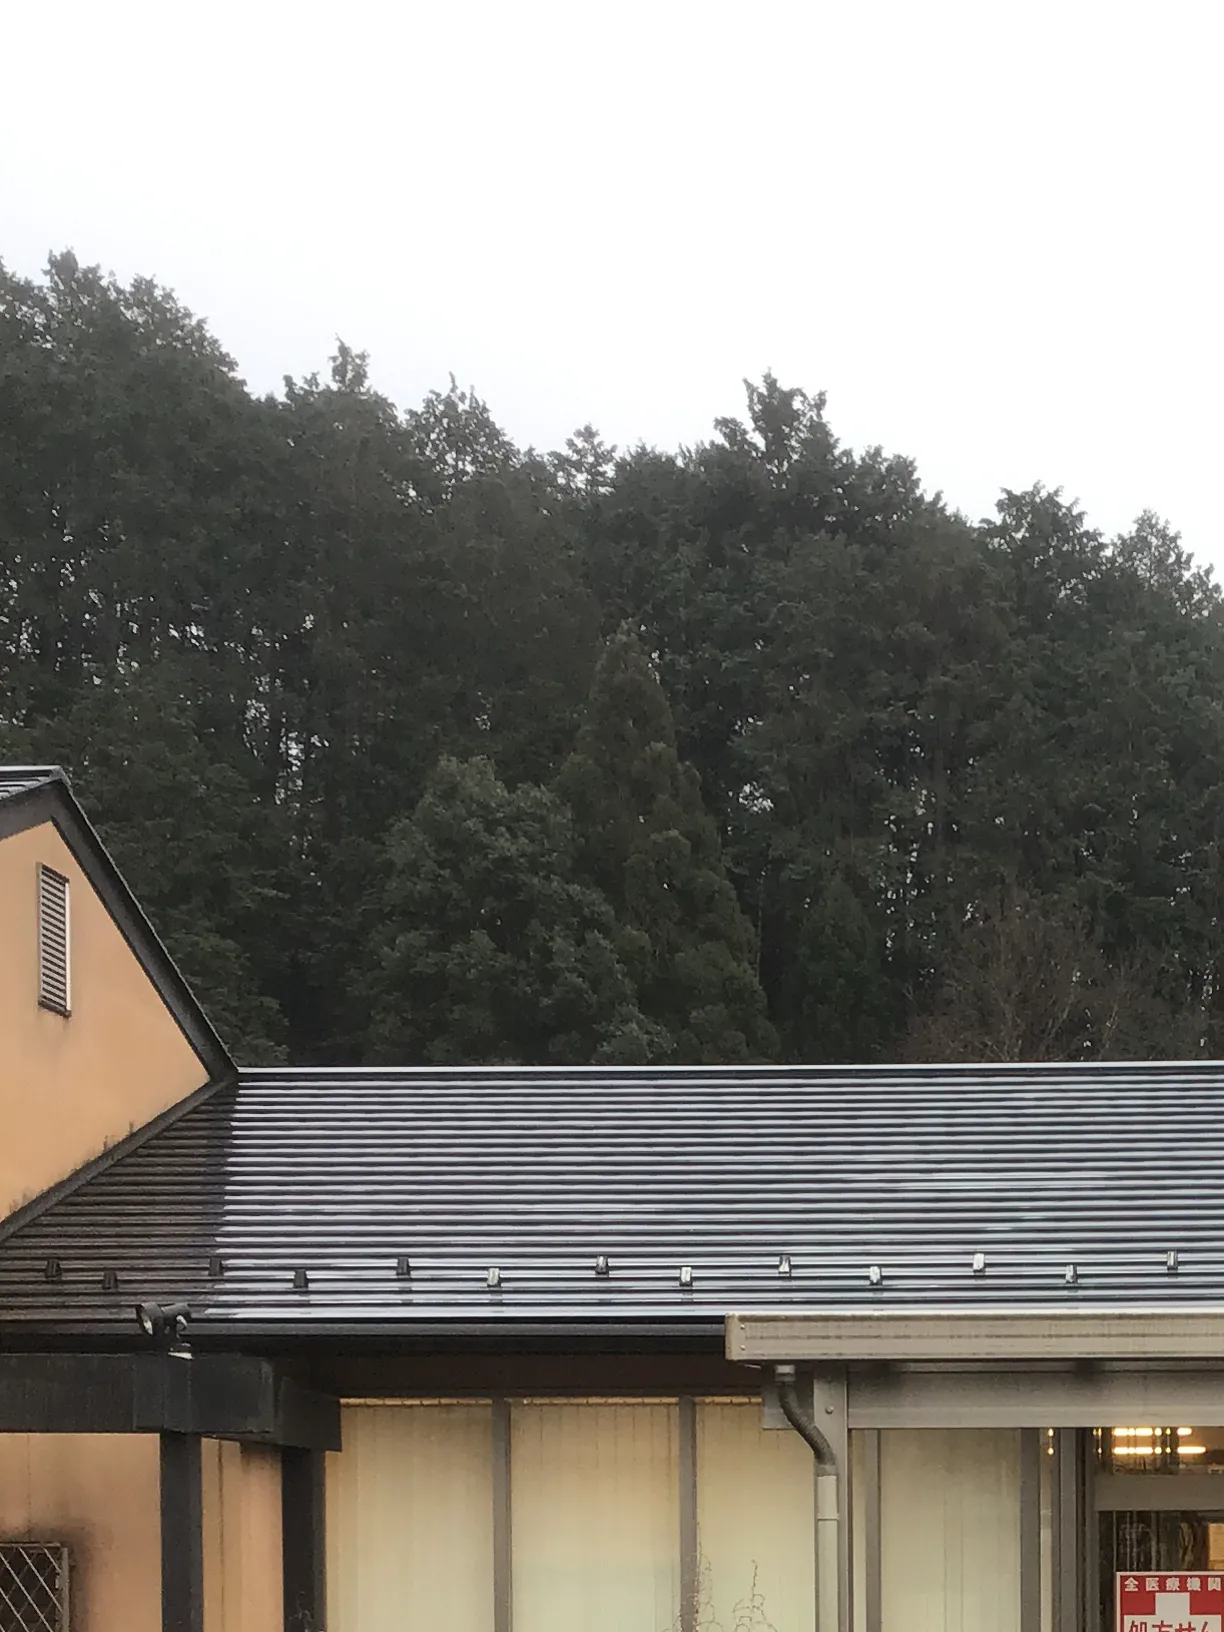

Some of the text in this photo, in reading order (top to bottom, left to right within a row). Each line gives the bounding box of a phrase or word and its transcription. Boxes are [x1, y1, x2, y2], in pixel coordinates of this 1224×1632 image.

[1124, 1577, 1221, 1591] 全医療機関
